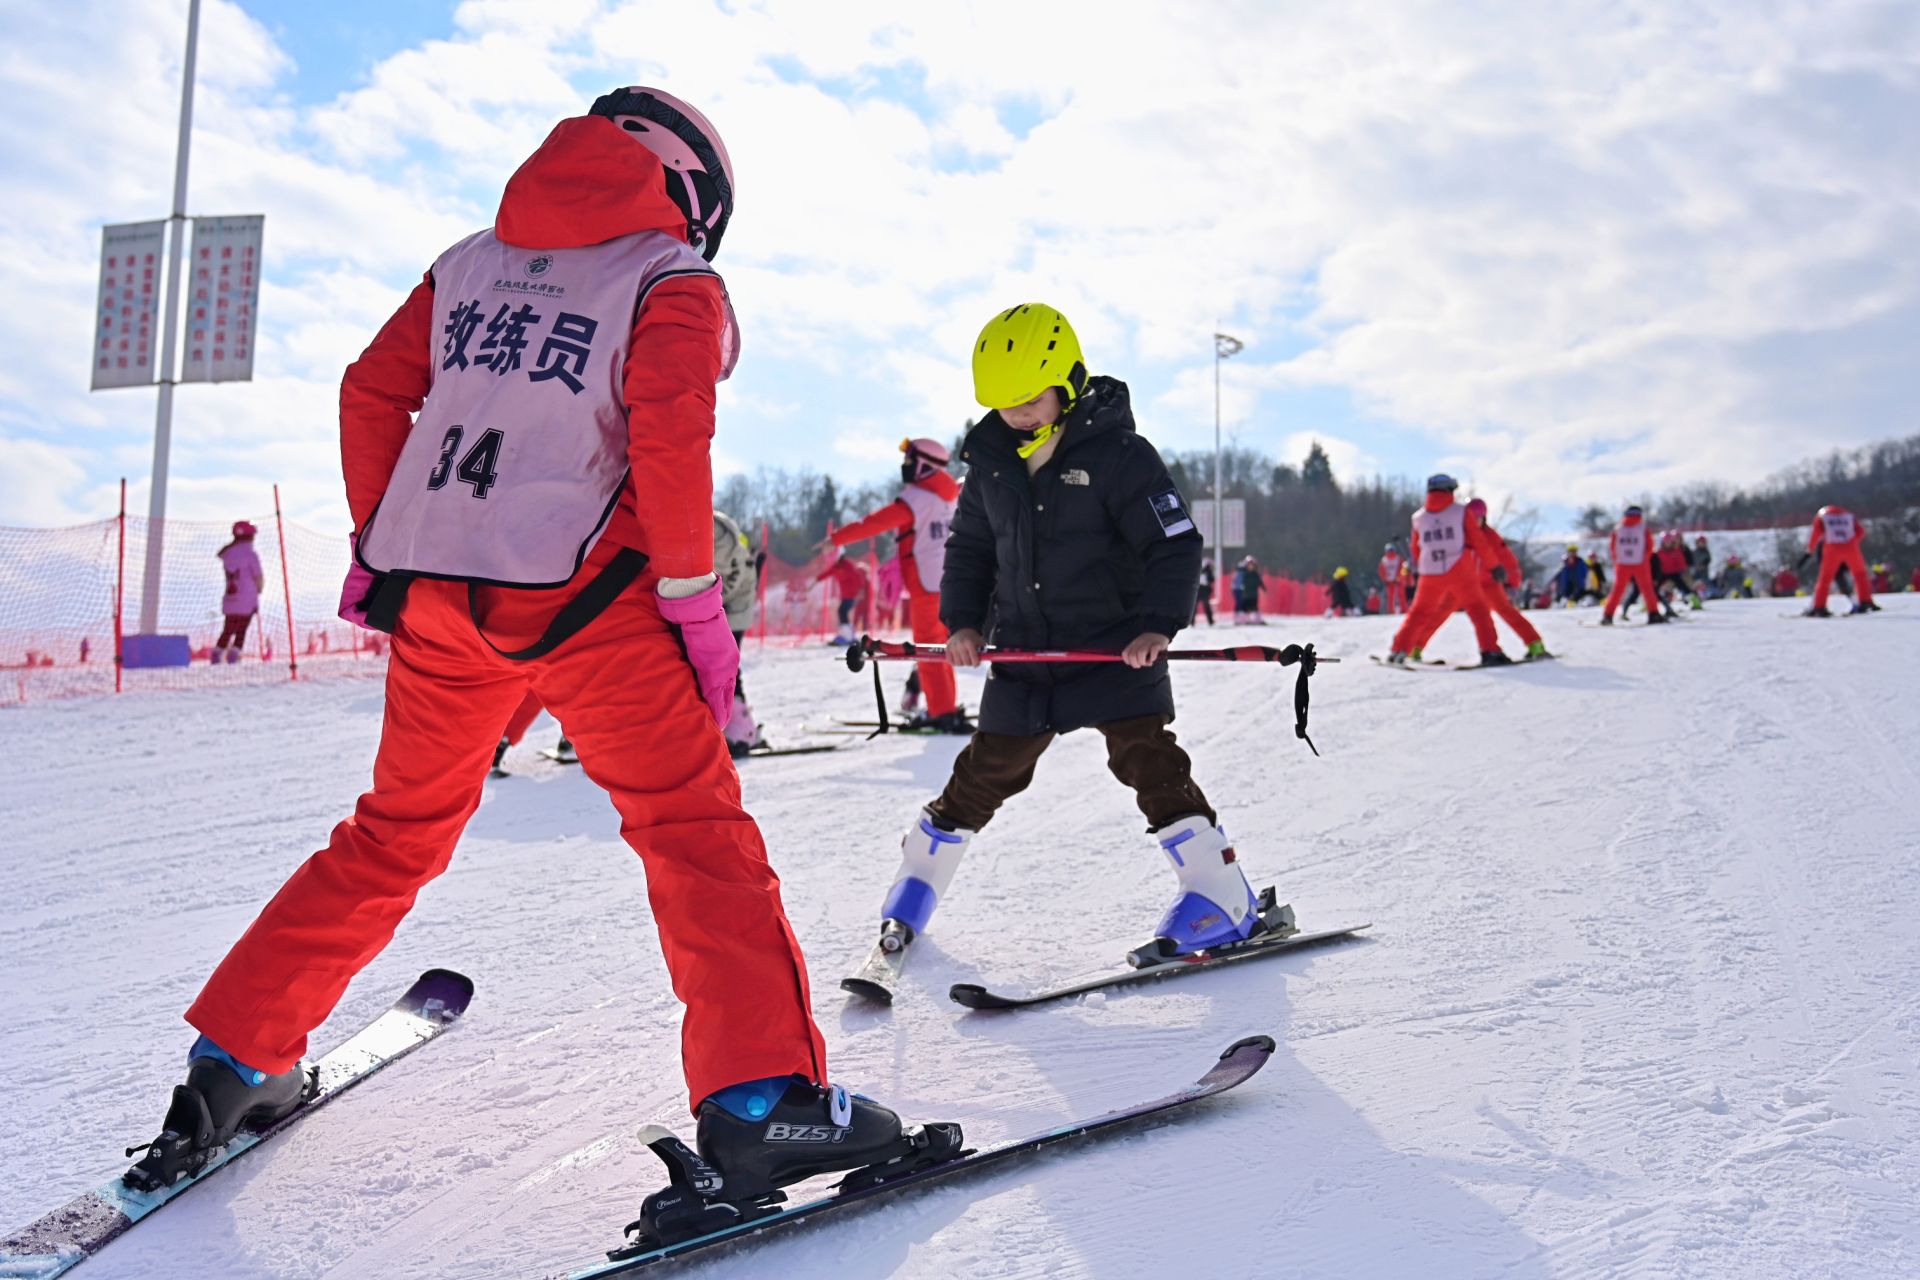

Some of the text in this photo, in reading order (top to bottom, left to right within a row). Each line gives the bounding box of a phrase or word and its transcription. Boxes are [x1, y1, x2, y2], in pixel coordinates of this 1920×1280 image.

[443, 300, 599, 395] 教练员
[427, 425, 504, 499] 34
[764, 1121, 853, 1143] BZST
